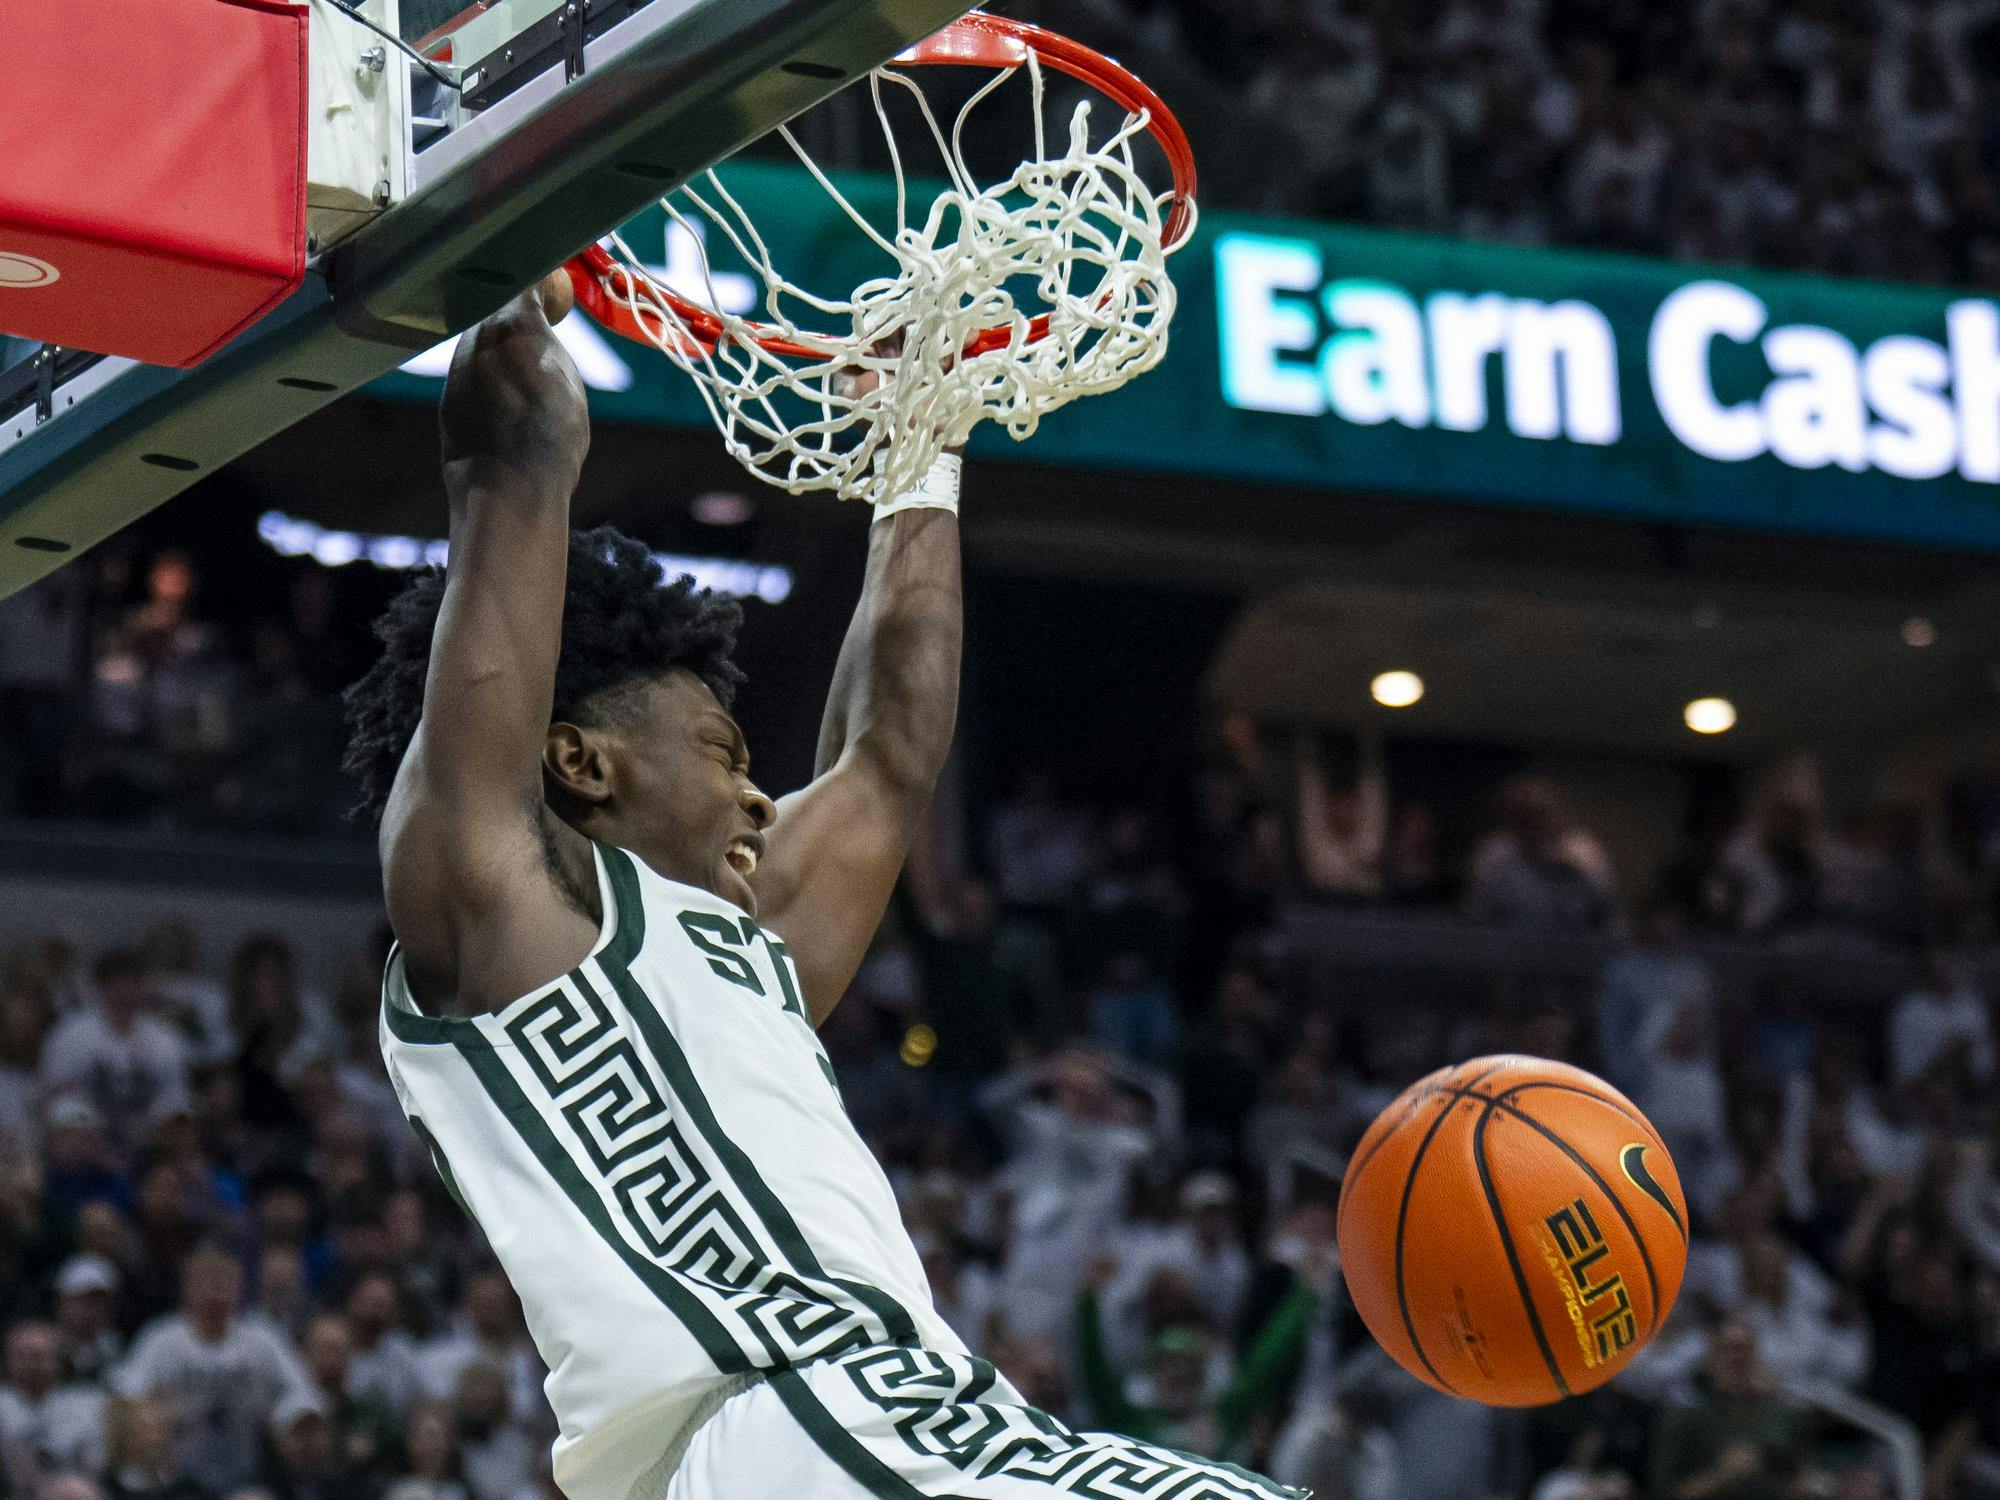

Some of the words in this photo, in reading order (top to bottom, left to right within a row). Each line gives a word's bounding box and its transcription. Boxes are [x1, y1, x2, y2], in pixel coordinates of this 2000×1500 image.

[1215, 233, 1622, 446] Earn
[676, 909, 813, 1031] ST
[1544, 1197, 1637, 1364] ELITE
